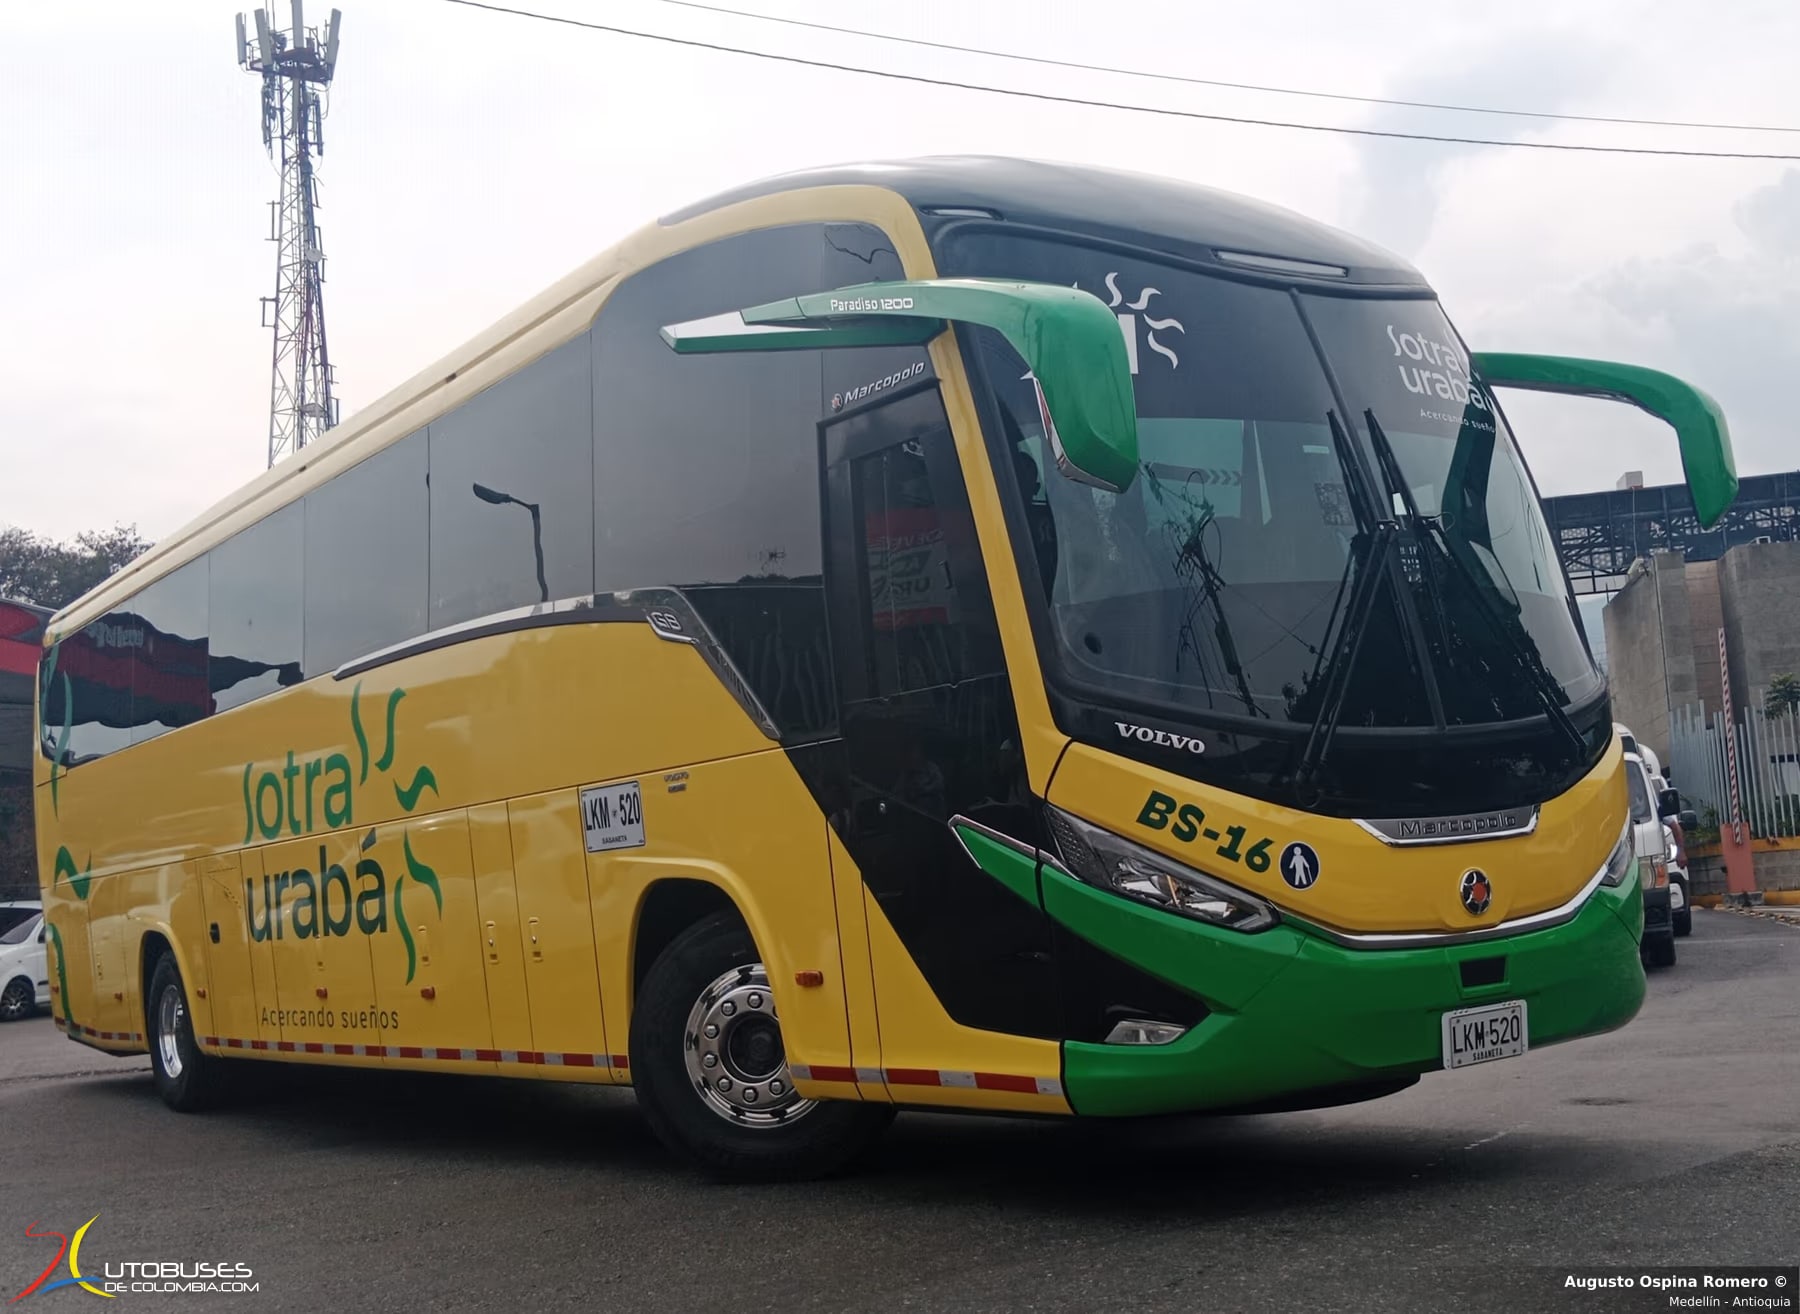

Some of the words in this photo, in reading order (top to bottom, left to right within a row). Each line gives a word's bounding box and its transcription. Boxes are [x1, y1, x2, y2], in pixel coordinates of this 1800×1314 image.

[830, 297, 879, 311] Paradiso
[880, 298, 914, 310] 1200
[844, 361, 925, 405] Marcopolo
[1114, 721, 1206, 754] VOLVO
[1136, 790, 1275, 873] BS-16
[1400, 813, 1517, 837] Marcopolo
[246, 827, 388, 943] urabá
[261, 1005, 335, 1028] Acercando
[341, 1004, 399, 1029] sueños
[1472, 1047, 1504, 1061] SABANETA
